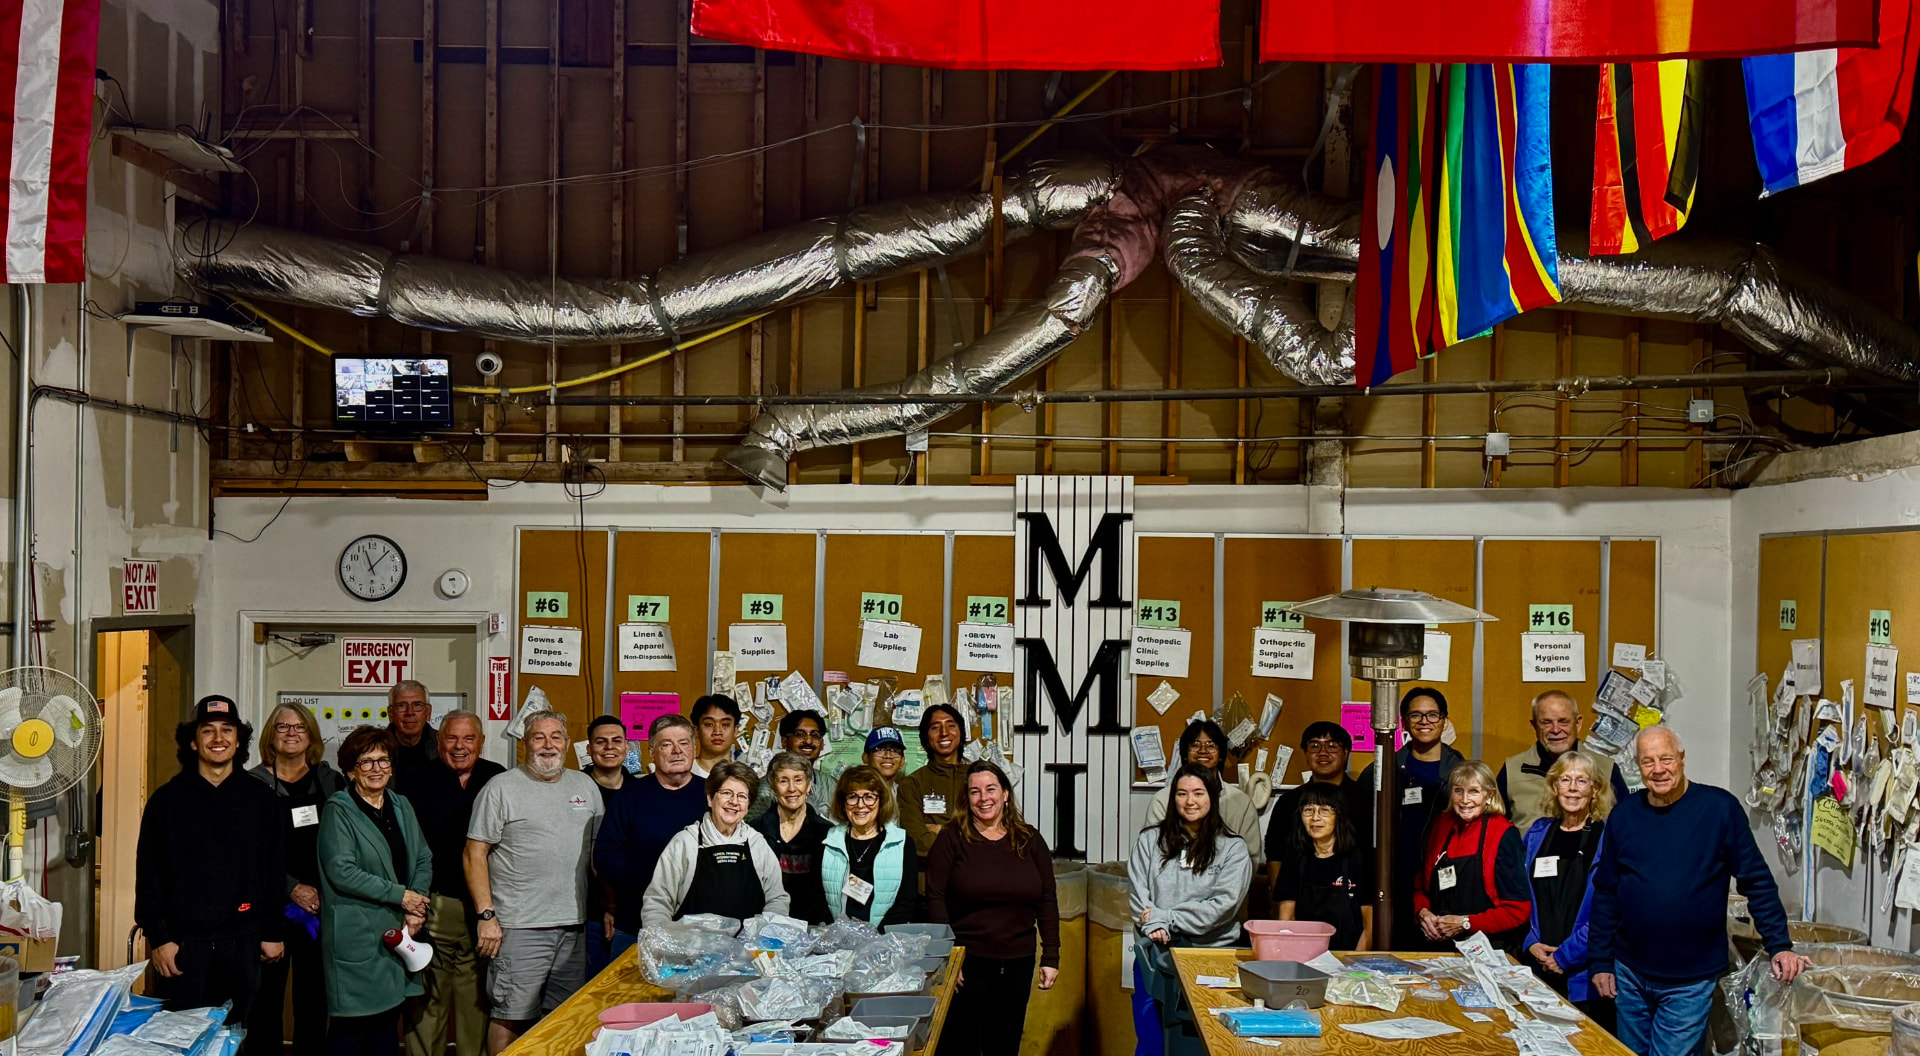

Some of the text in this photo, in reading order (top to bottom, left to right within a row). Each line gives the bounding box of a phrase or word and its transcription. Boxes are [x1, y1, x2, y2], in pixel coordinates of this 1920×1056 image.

[357, 545, 365, 553] 11
[368, 541, 377, 550] 12
[350, 553, 359, 562] 10
[125, 563, 157, 583] NOT AN
[125, 585, 157, 610] EXIT
[535, 598, 560, 613] #6
[636, 602, 661, 617] #7
[750, 600, 774, 615] #9
[863, 599, 900, 616] #10
[969, 603, 1006, 618] #12
[1140, 605, 1177, 622] #13
[1264, 606, 1302, 623] #14
[1780, 607, 1796, 624] #18
[1531, 611, 1571, 627] #16
[1870, 619, 1890, 637] #19
[633, 630, 656, 638] Linen
[883, 631, 899, 640] Lab
[527, 635, 555, 644] Gowns
[1137, 636, 1181, 646] Orthopedic
[1259, 638, 1306, 648] Orthopedic
[346, 642, 410, 657] EMERGENCY
[633, 642, 664, 650] Apparel
[872, 641, 907, 652] Supplies
[1533, 642, 1571, 650] Personal
[533, 648, 562, 656] Drapes
[741, 647, 776, 656] Supplies
[969, 651, 998, 659] Supplies
[1136, 647, 1159, 656] Clinic
[1259, 650, 1294, 659] Surgical
[623, 653, 673, 661] Non-Disposable
[1535, 653, 1570, 662] Hygiene
[492, 662, 507, 671] FIRE
[527, 658, 573, 668] Disposable
[1135, 658, 1170, 668] Supplies
[1258, 660, 1294, 670] Supplies
[348, 660, 408, 684] EXIT
[1534, 665, 1571, 674] Supplies
[304, 697, 319, 705] LIST
